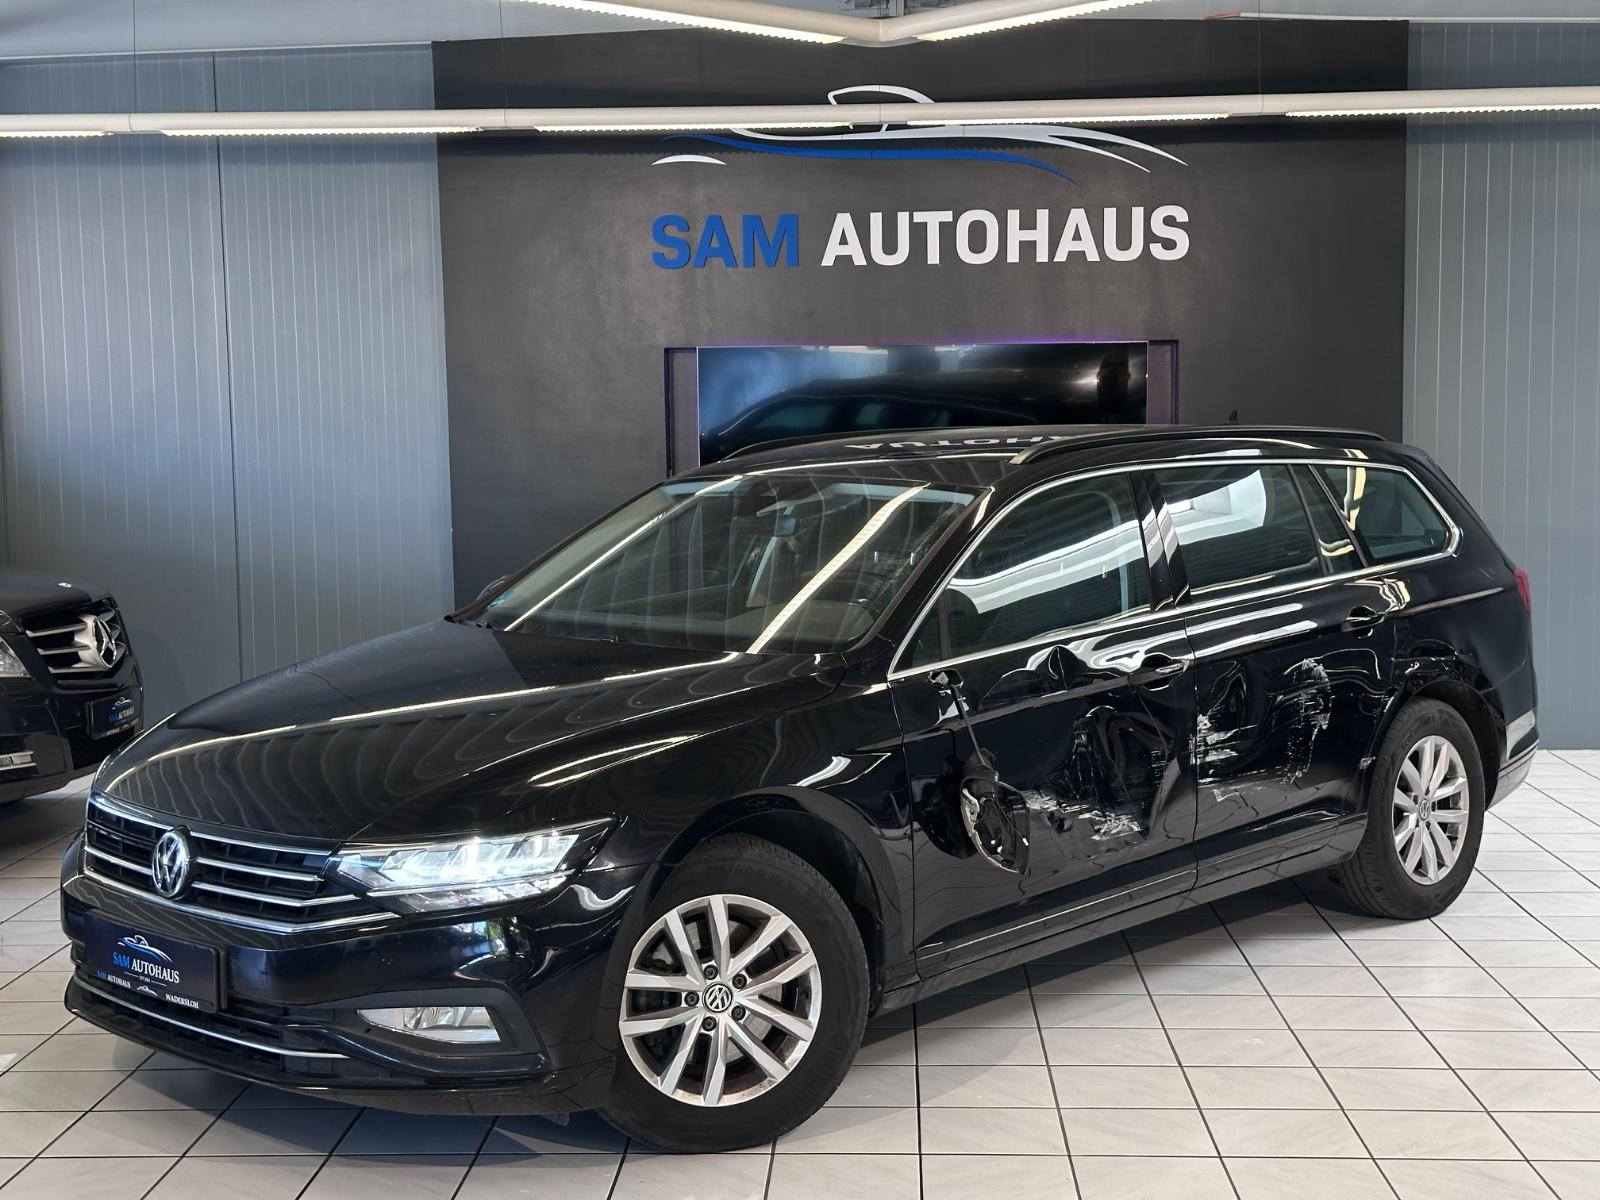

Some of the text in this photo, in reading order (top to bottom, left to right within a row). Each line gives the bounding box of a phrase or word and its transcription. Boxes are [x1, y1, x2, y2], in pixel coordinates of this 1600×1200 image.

[652, 204, 1191, 269] SAM AUTOHAUS
[112, 951, 180, 984] SAM AUTOHAUS
